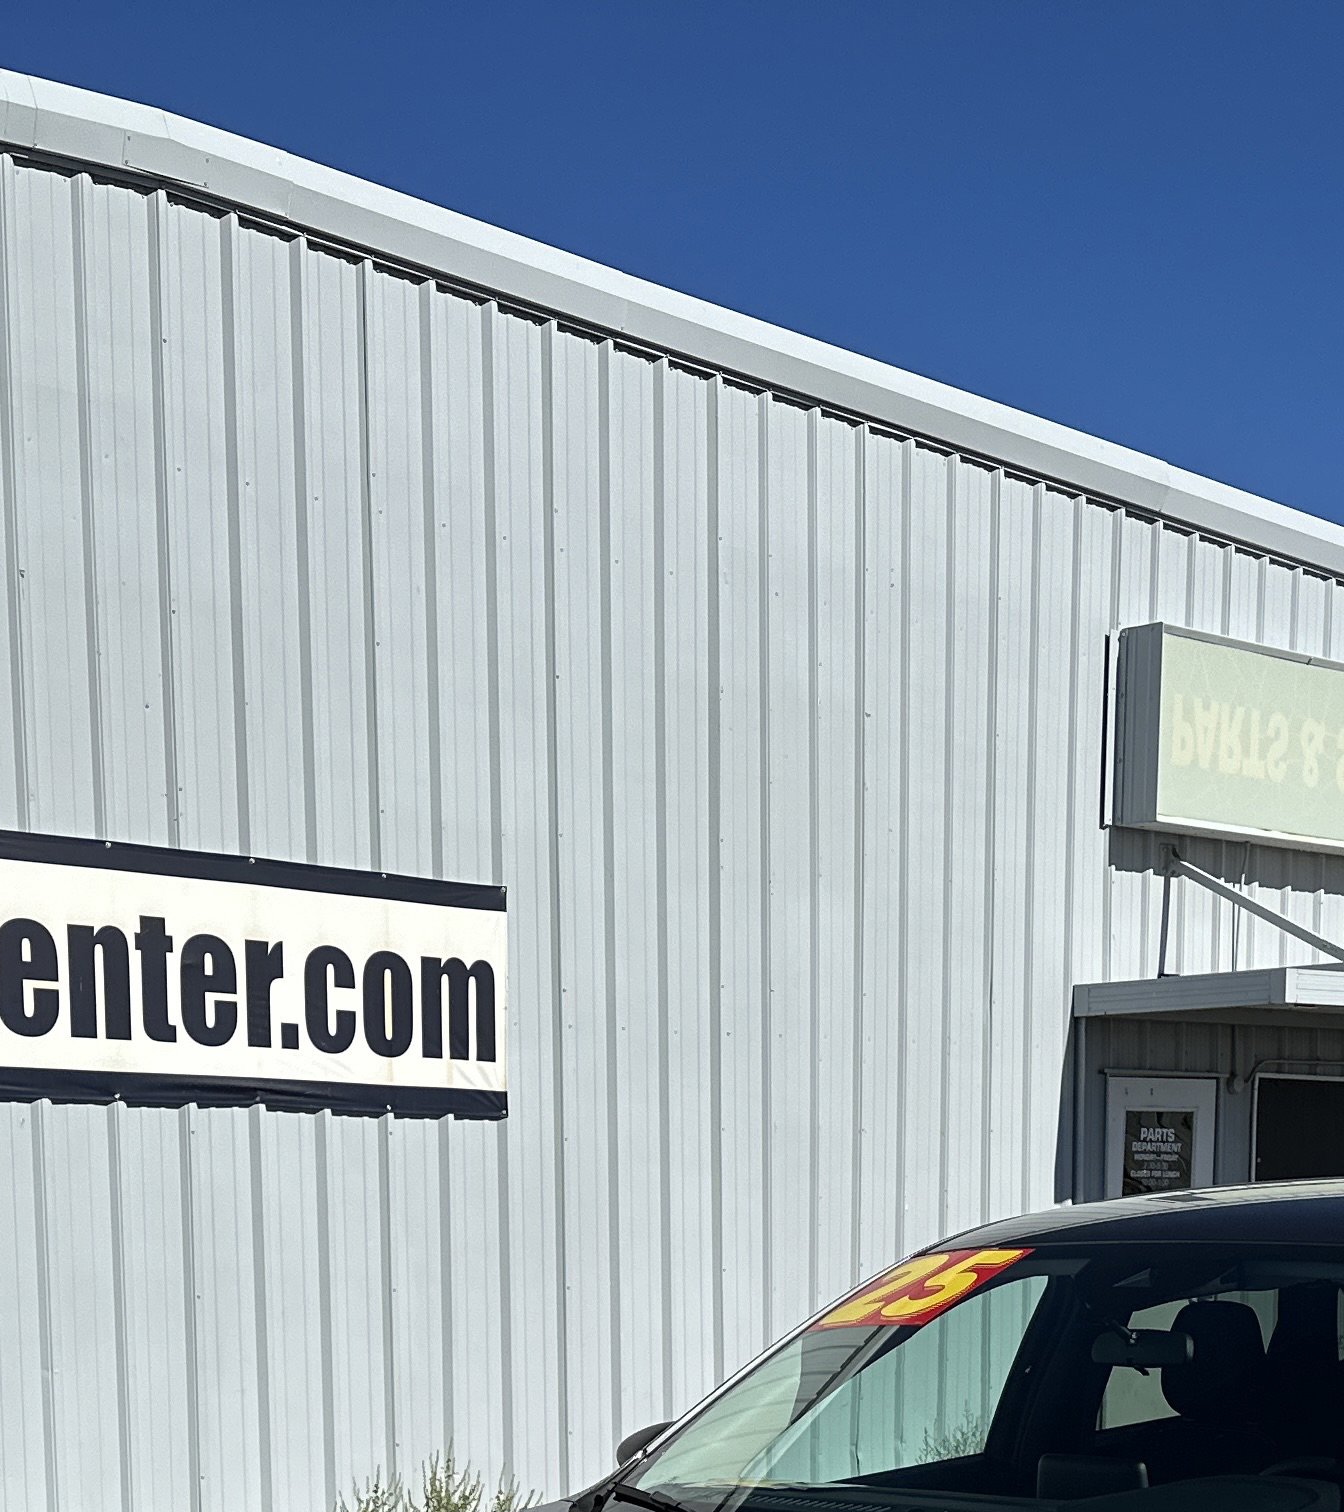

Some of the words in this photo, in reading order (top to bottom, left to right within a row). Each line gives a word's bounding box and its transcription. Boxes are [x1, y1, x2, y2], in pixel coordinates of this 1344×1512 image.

[1140, 1127, 1175, 1142] PARTS
[1131, 1141, 1183, 1152] DEPARTMENT
[817, 1249, 1026, 1327] 25
